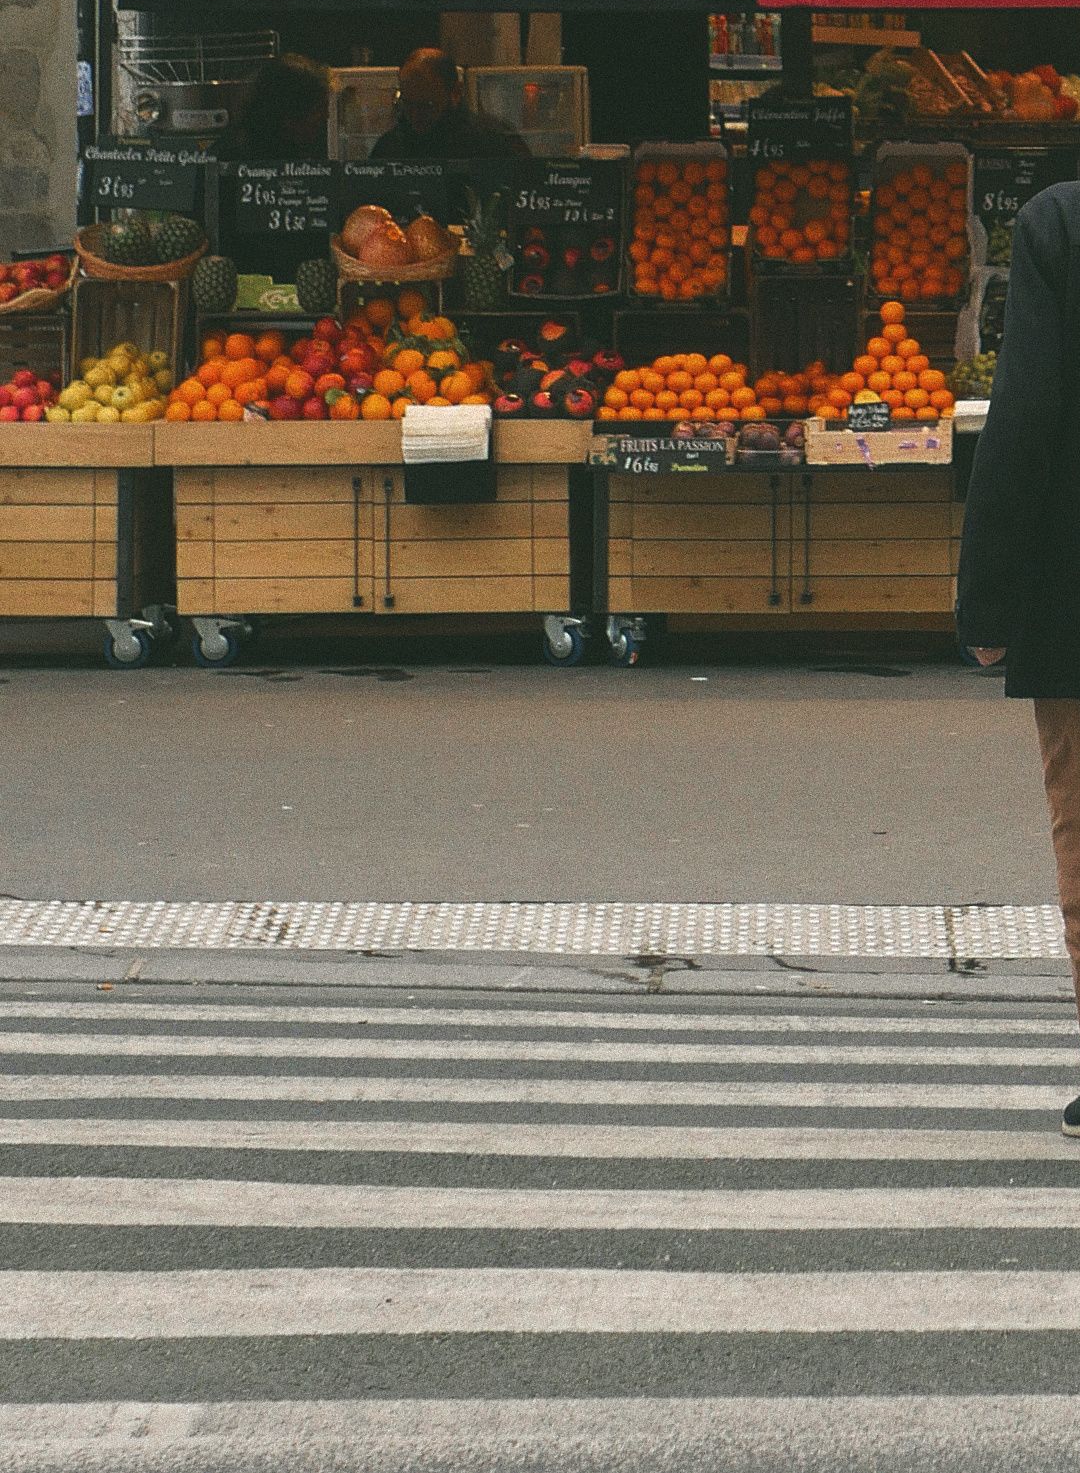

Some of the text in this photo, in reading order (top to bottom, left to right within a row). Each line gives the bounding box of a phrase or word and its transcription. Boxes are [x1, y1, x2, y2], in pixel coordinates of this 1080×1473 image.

[238, 165, 278, 180] Orange
[344, 163, 385, 179] Orange
[620, 439, 725, 453] FRUITS LA PASSION
